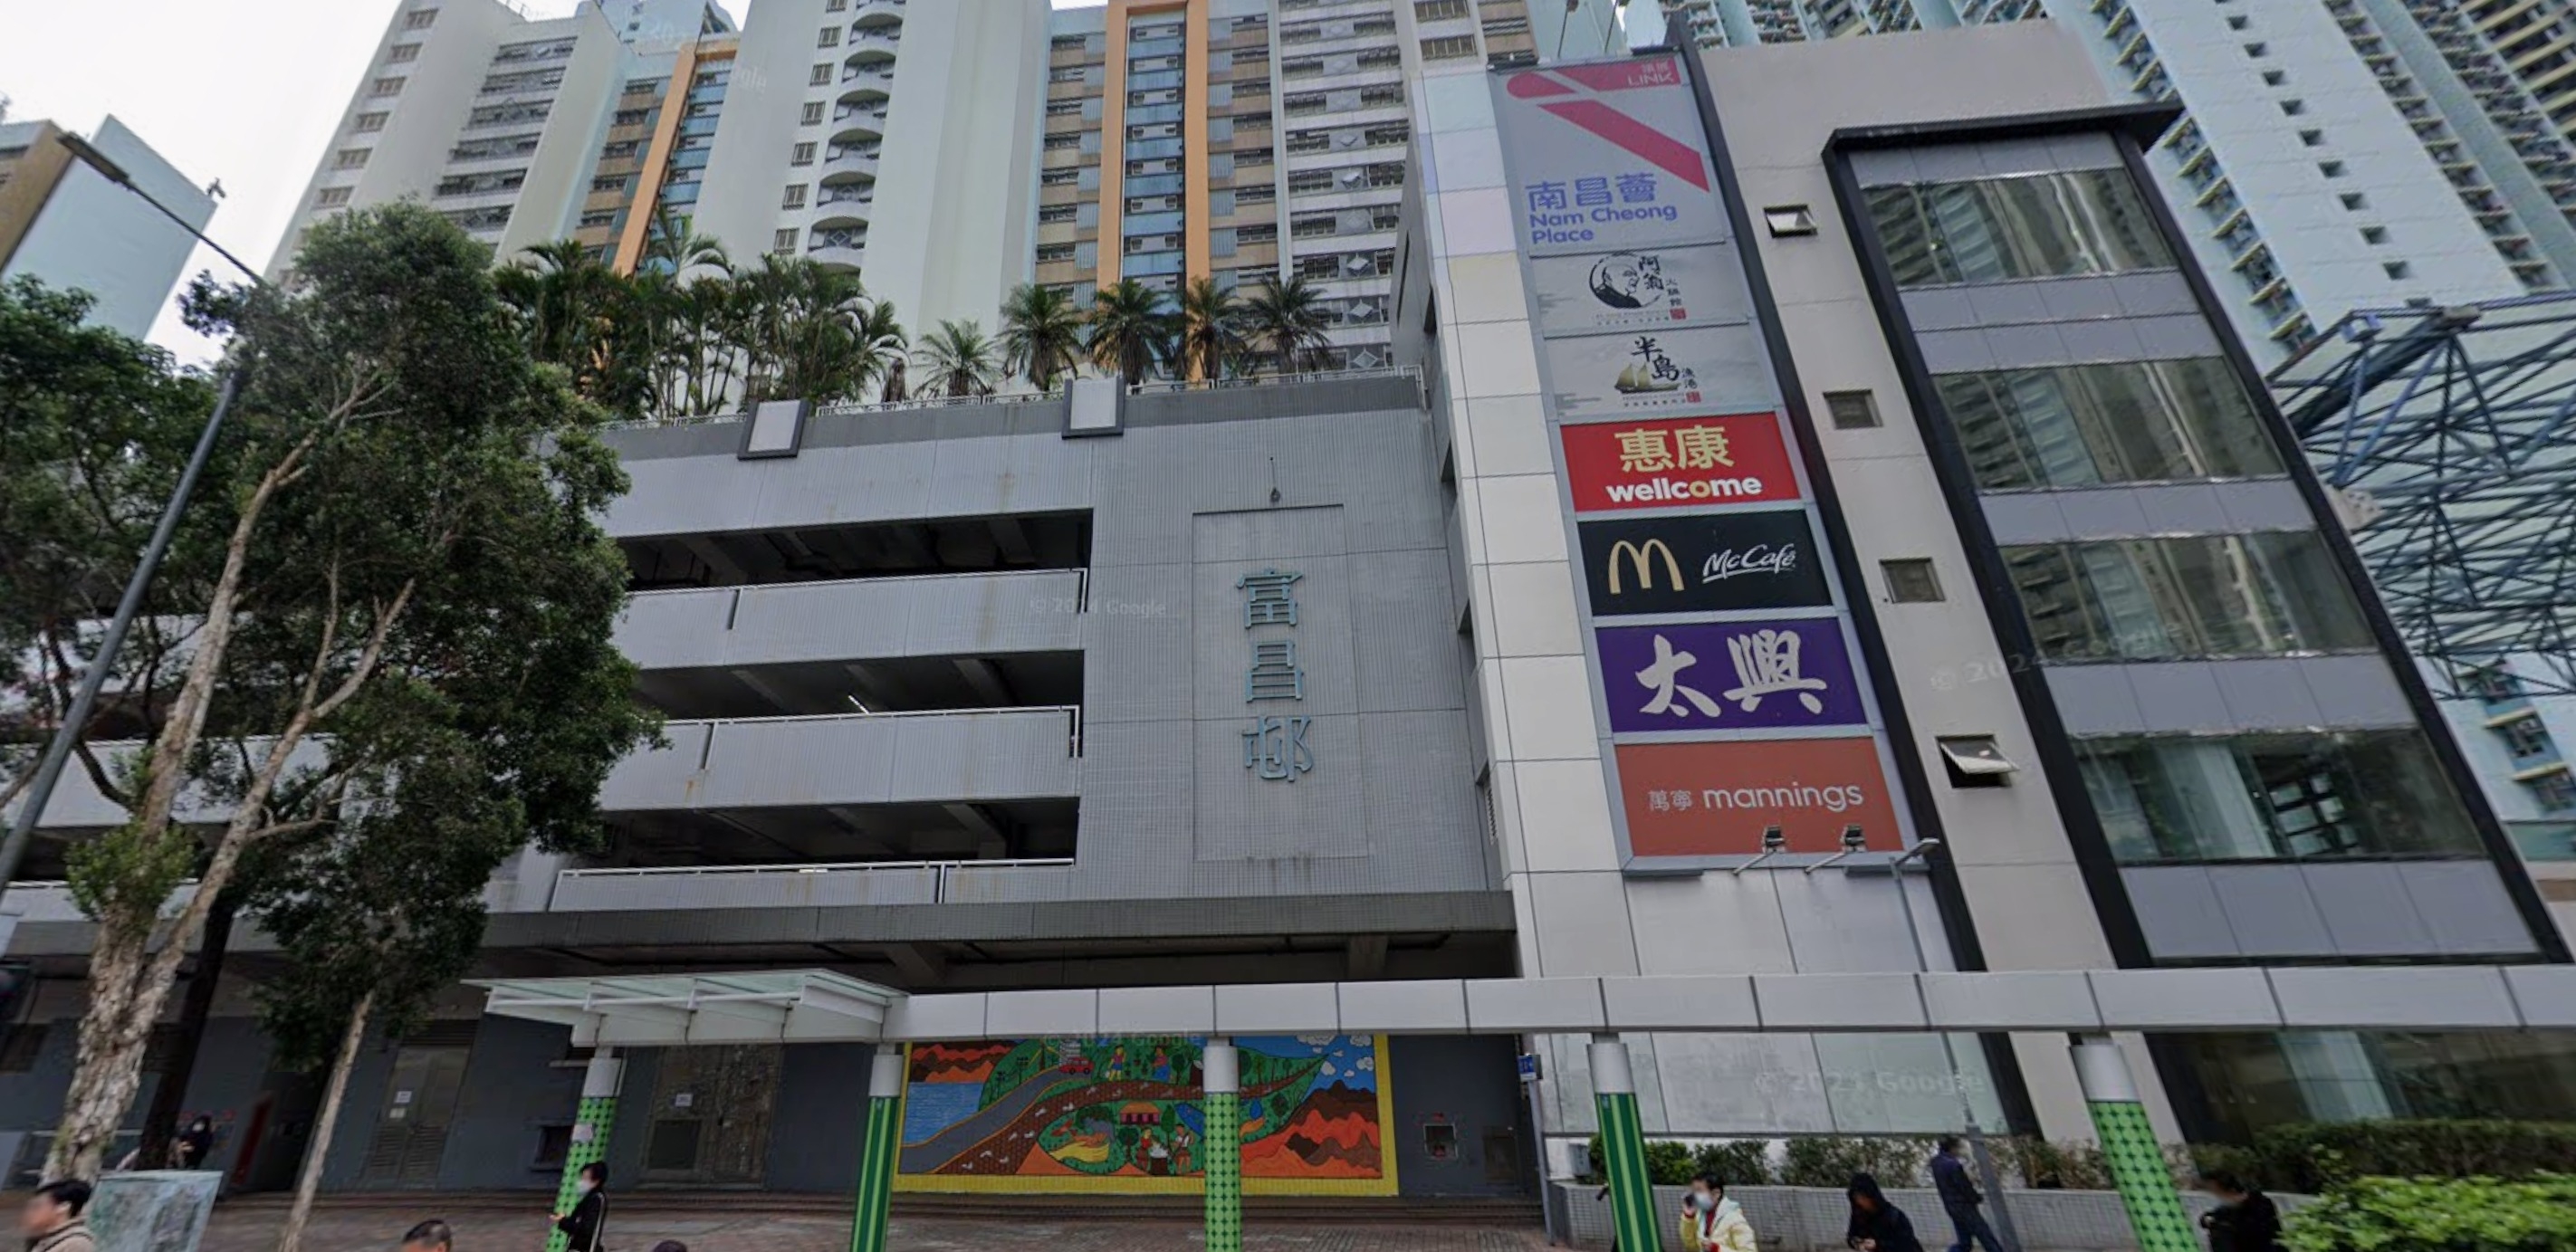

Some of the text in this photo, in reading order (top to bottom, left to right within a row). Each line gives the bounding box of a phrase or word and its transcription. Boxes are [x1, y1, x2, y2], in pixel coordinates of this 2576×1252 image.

[1627, 72, 1674, 86] LINK
[1525, 172, 1657, 212] 南昌薈
[1529, 203, 1677, 228] Nam Cheong
[1531, 228, 1594, 245] Place
[1631, 336, 1681, 381] 半島
[1614, 425, 1734, 473] 惠康
[1606, 477, 1763, 502] wellcome
[1237, 568, 1313, 781] 富昌邨
[1635, 629, 1827, 717] 太興
[1648, 789, 1693, 812] 萬寧
[1702, 781, 1864, 813] mannings
